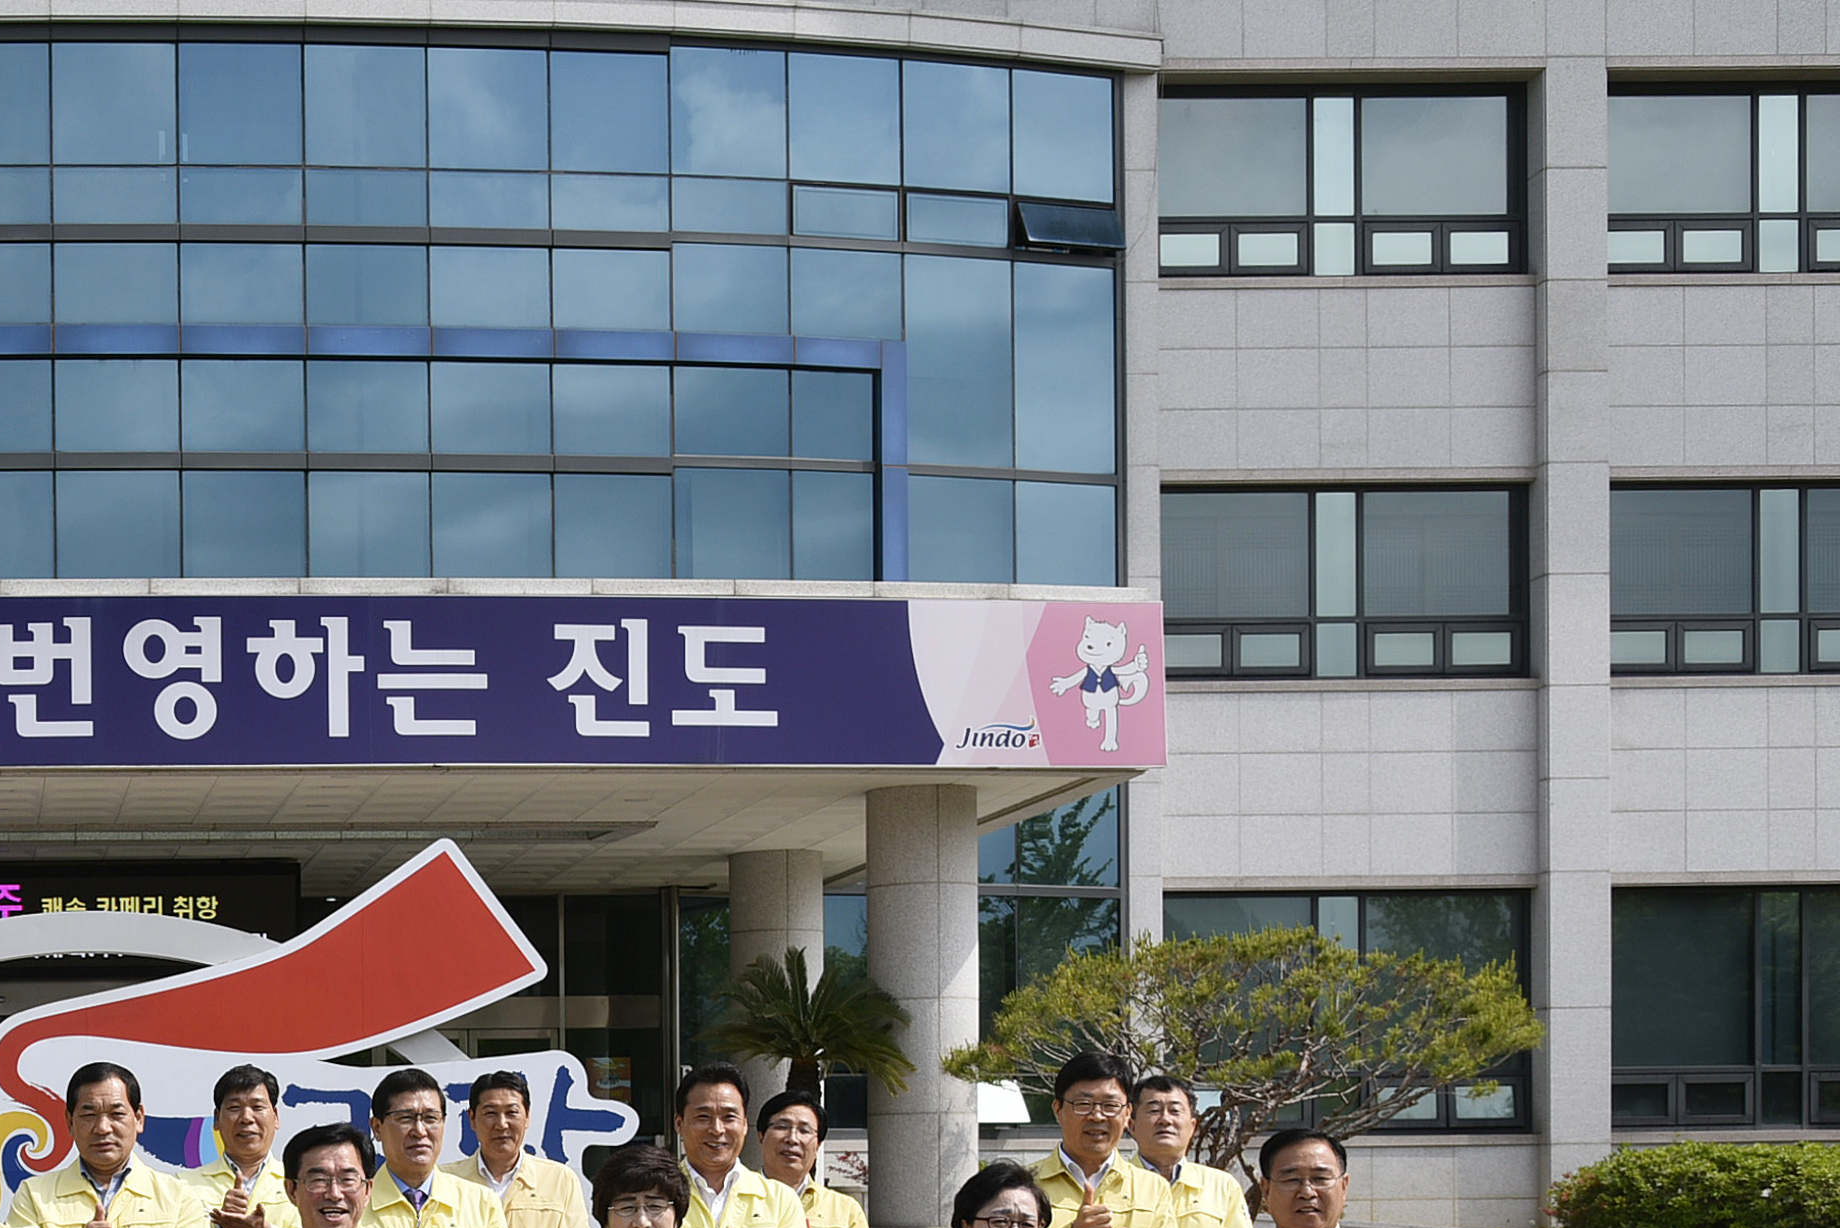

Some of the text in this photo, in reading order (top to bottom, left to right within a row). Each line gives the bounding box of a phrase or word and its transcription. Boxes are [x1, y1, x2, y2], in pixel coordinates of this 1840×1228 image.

[547, 618, 779, 737] 진도
[956, 728, 1026, 749] Jindo
[173, 895, 219, 920] 취항
